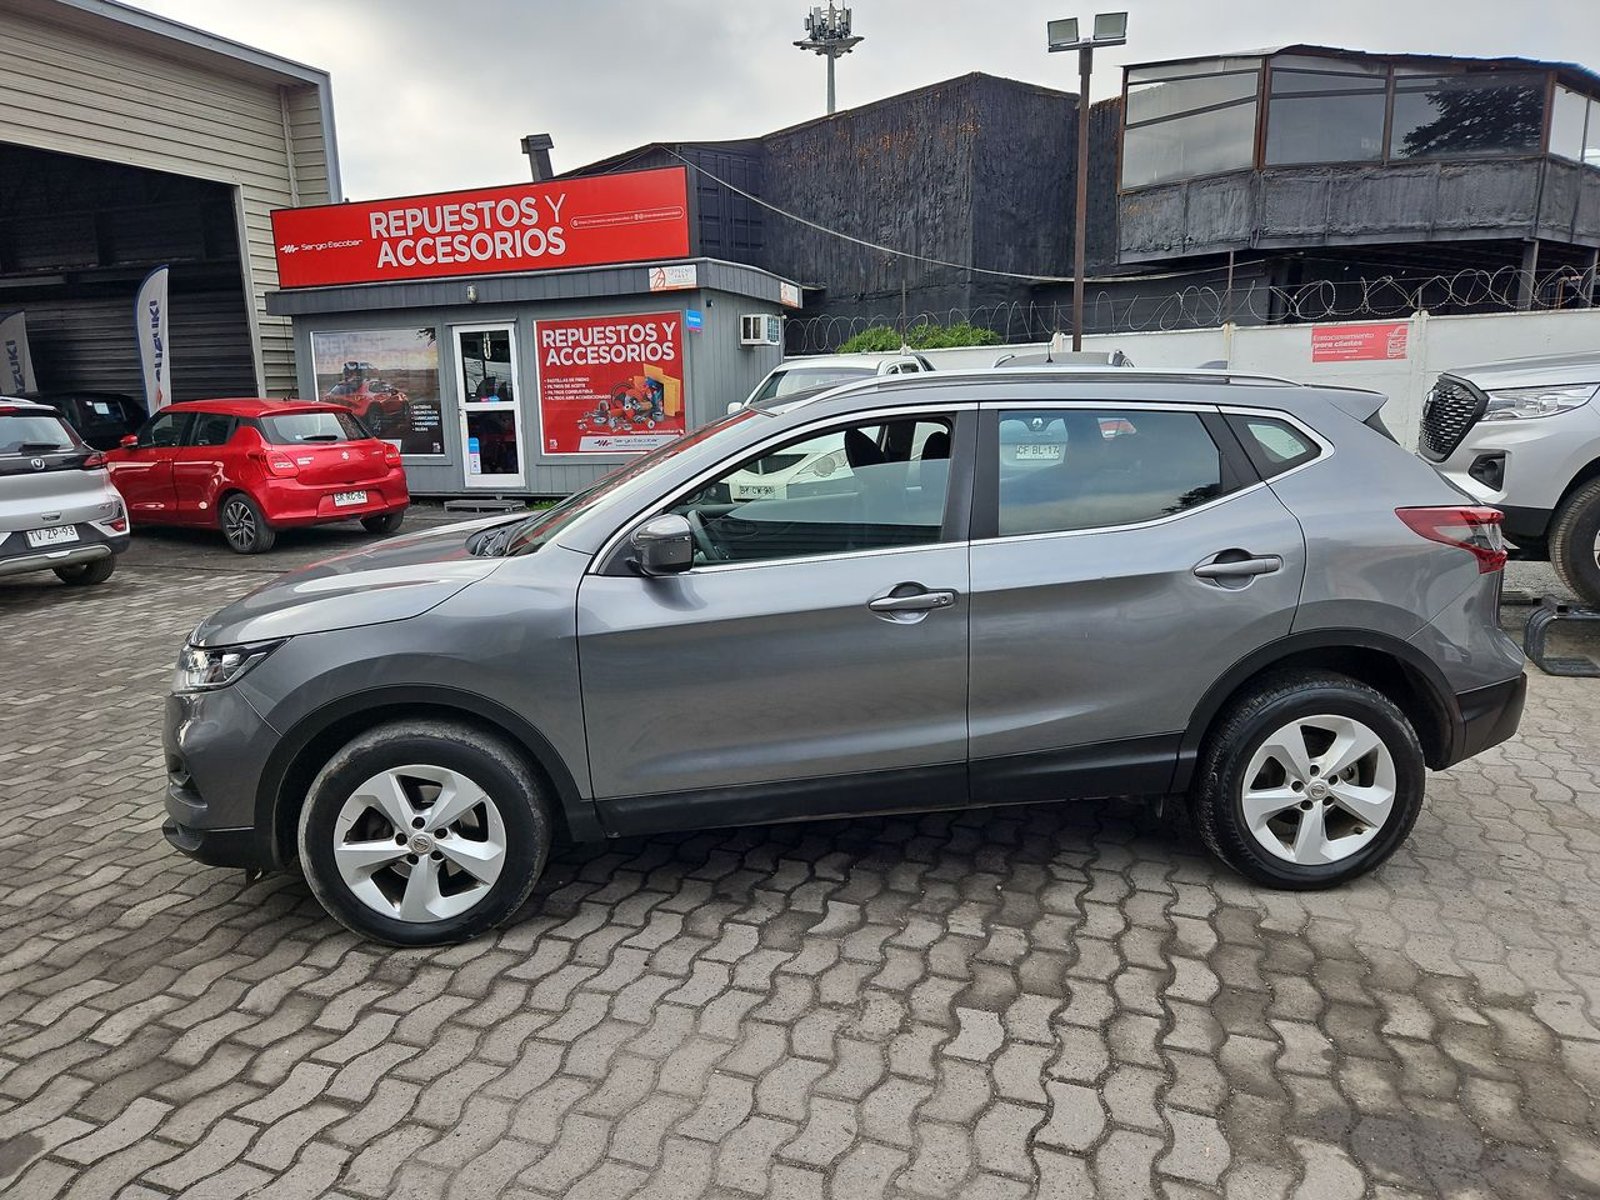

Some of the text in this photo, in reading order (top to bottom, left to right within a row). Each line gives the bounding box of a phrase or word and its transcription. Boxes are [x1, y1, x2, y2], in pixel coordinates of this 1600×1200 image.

[370, 193, 566, 239] REPUESTOS Y
[377, 226, 566, 268] ACCESORIOS
[542, 321, 677, 348] REPUESTOS Y
[1314, 332, 1375, 341] Estacionamiento
[546, 342, 675, 367] ACCESORIOS
